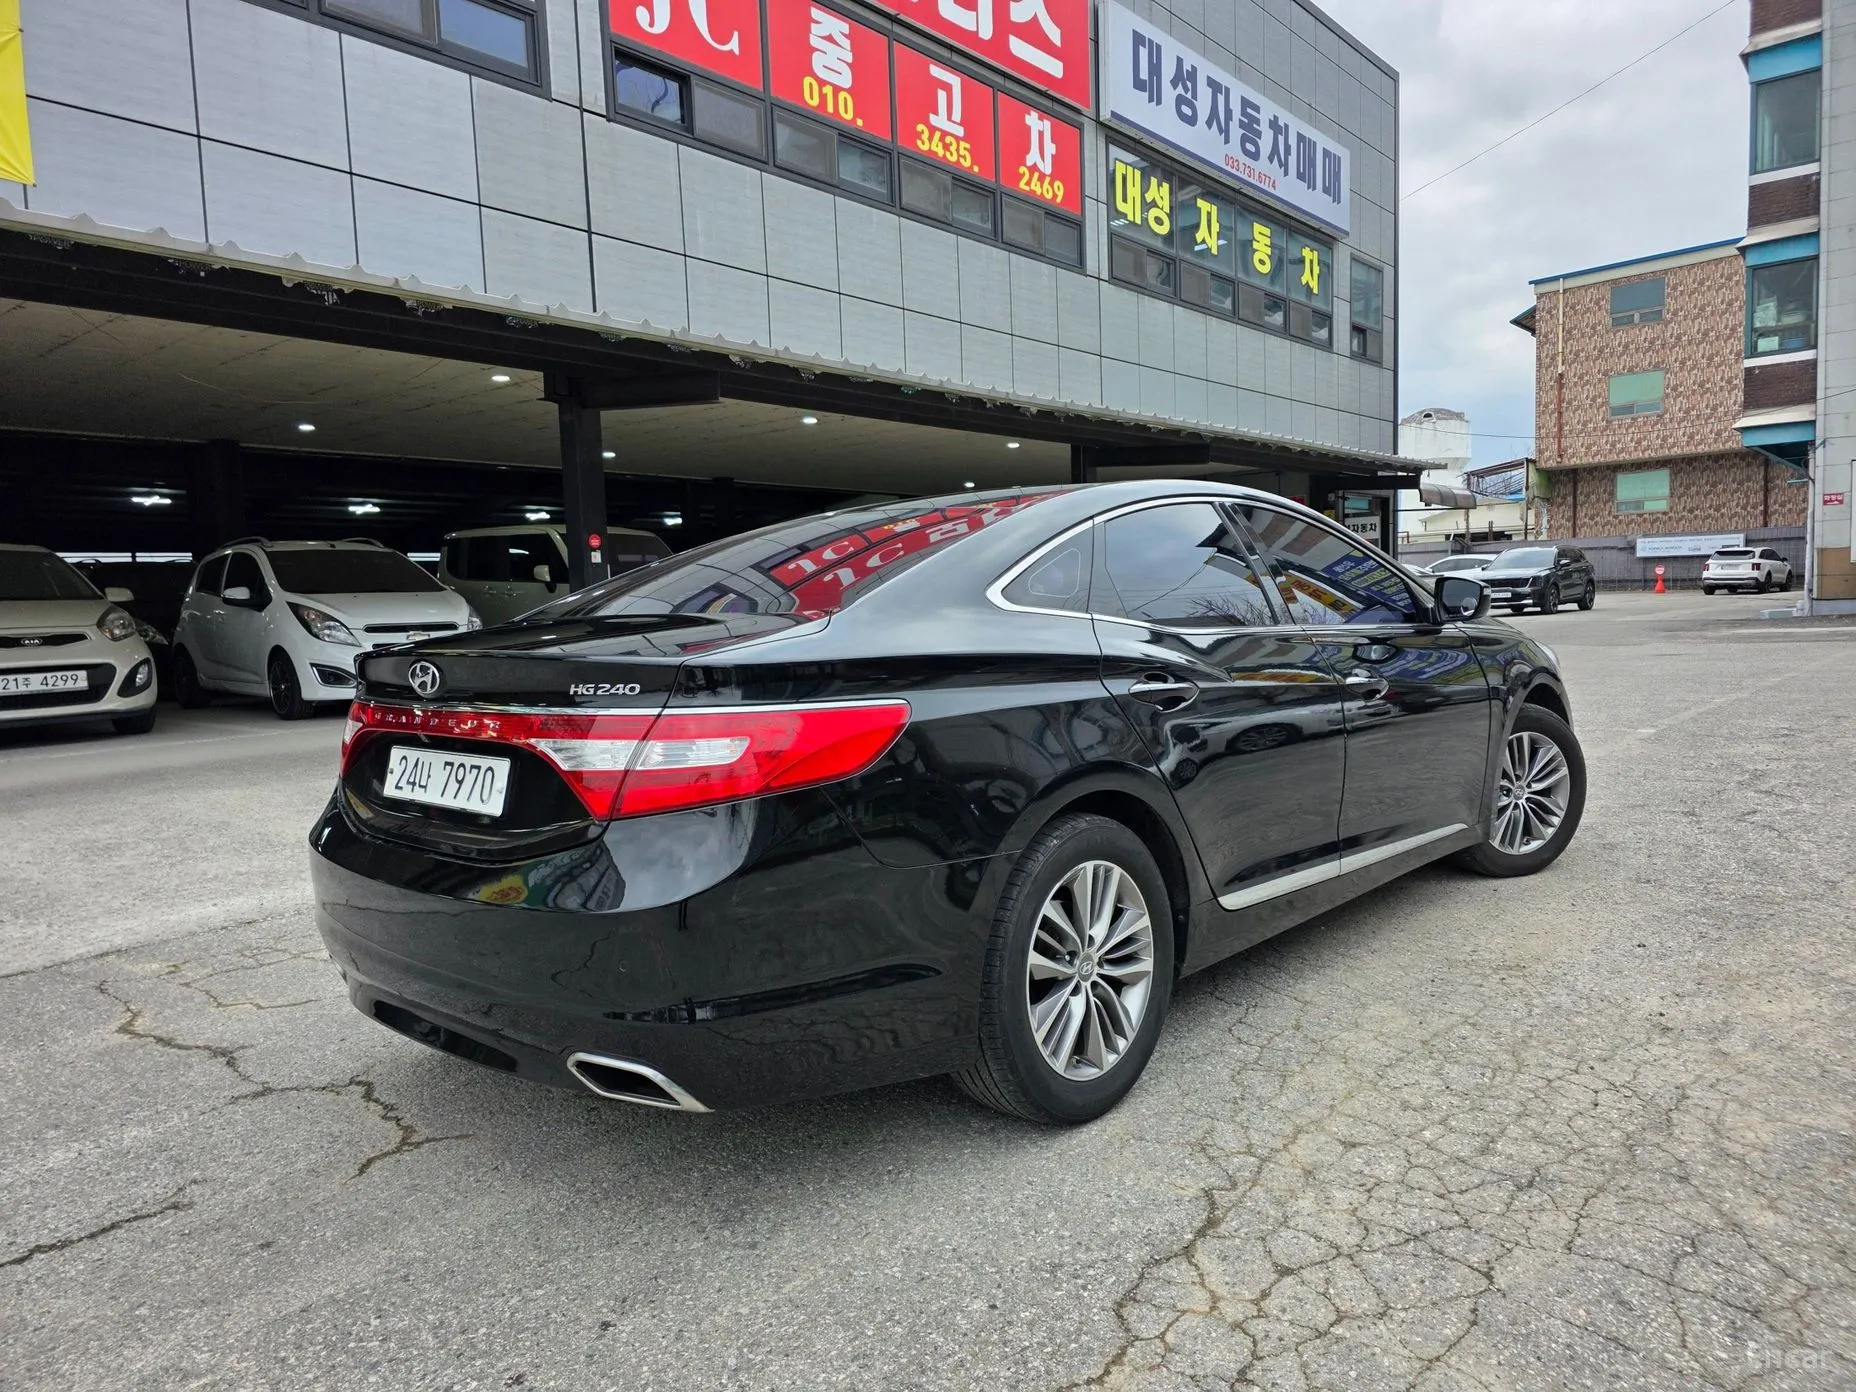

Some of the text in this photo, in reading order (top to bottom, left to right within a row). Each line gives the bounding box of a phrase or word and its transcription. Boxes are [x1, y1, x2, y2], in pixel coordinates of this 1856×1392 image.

[809, 6, 1056, 175] 중 고 차
[1132, 29, 1341, 205] 대성자동차매매
[1018, 165, 1064, 203] 2469
[1224, 152, 1277, 191] 033.731.6774
[1114, 159, 1171, 236] 대성
[1, 674, 79, 690] 21주 4299
[440, 761, 495, 805] 7970
